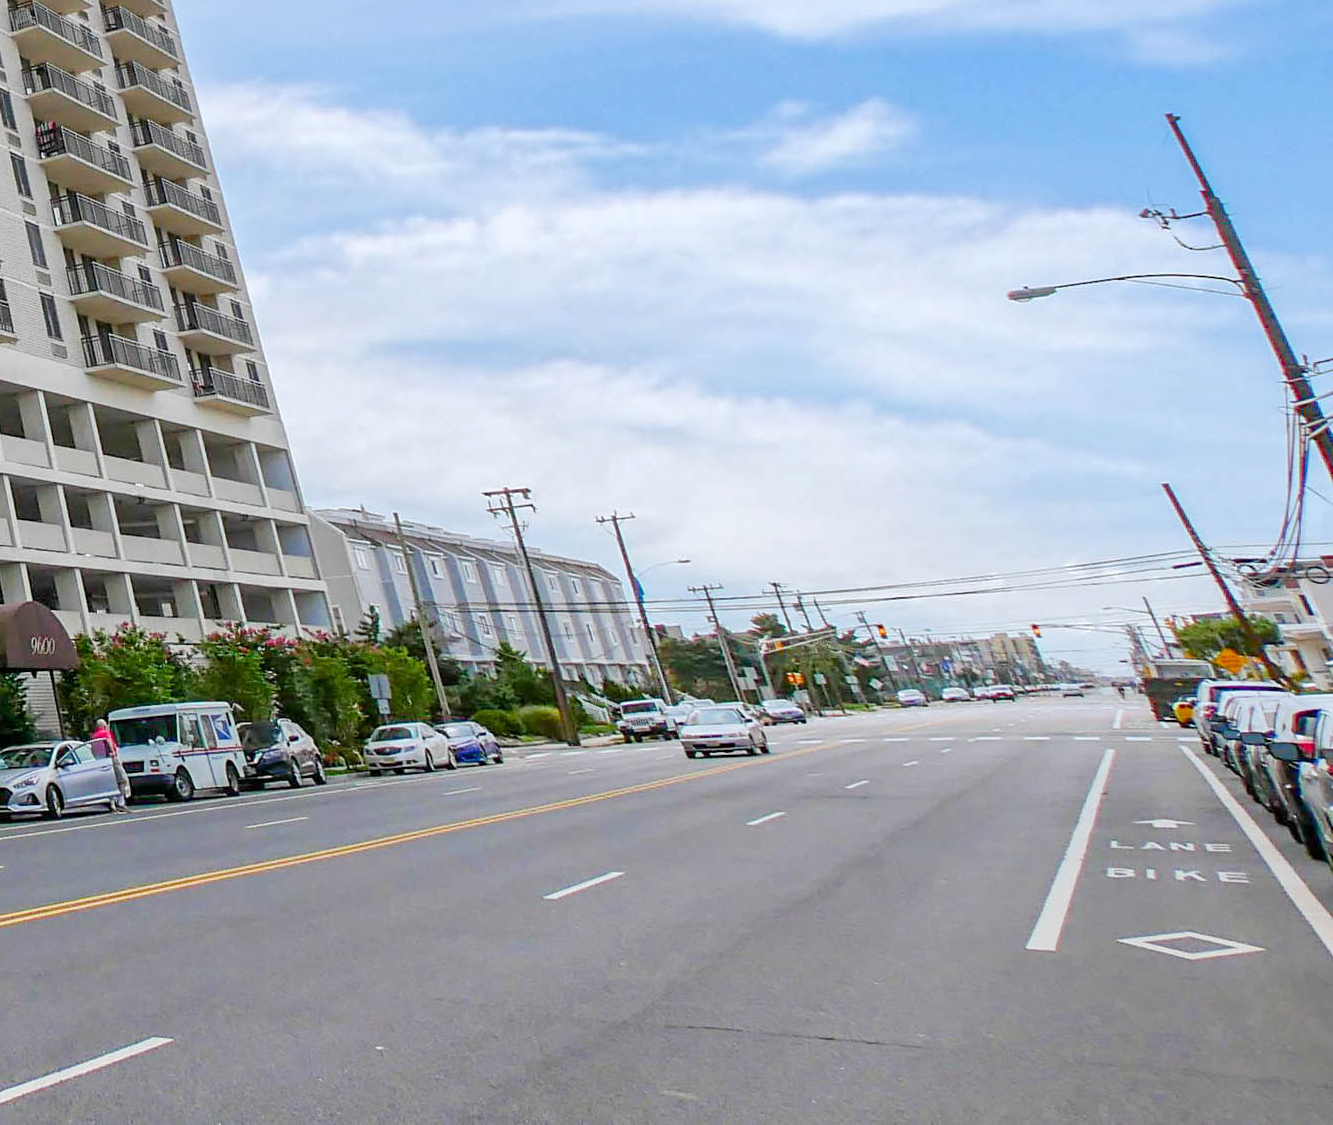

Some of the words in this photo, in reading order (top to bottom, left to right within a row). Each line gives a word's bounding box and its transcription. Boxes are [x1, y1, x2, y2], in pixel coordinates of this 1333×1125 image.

[31, 636, 56, 655] 9600
[1109, 840, 1232, 852] LANE
[1106, 867, 1251, 883] BIKE
